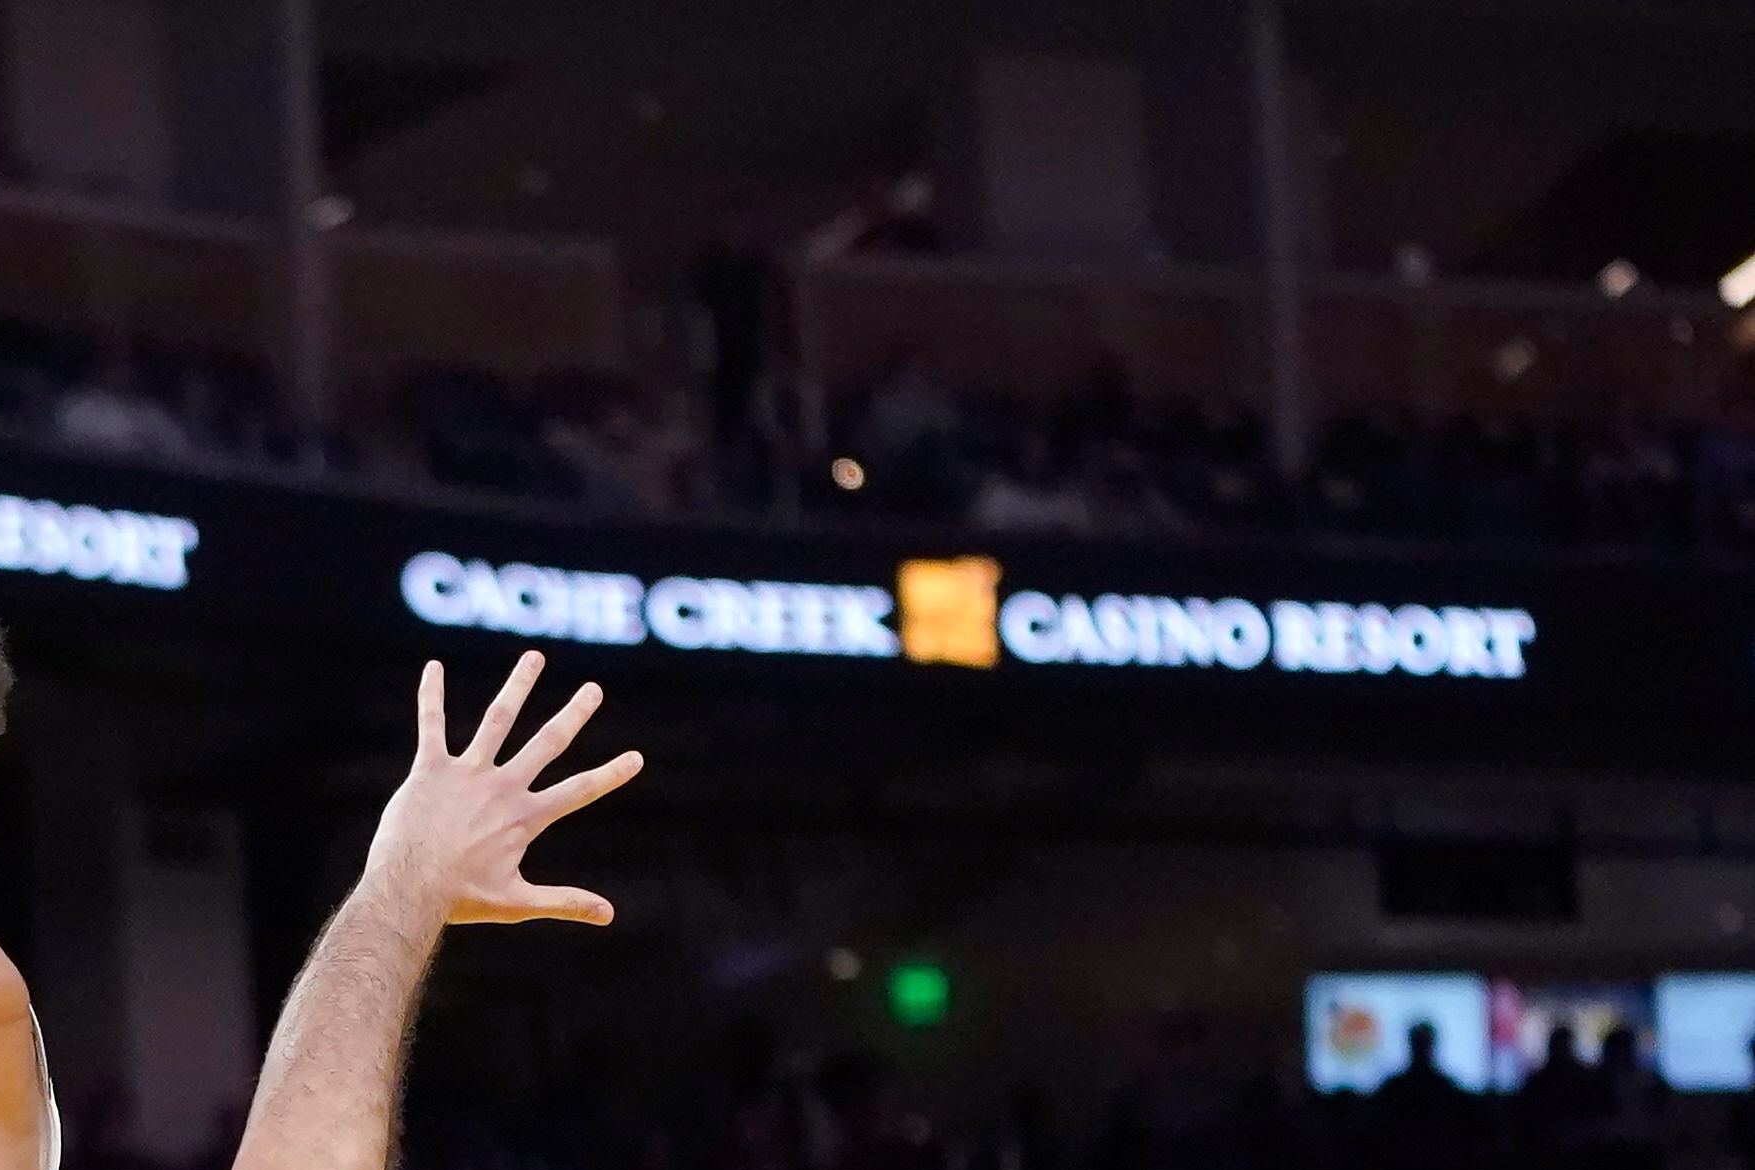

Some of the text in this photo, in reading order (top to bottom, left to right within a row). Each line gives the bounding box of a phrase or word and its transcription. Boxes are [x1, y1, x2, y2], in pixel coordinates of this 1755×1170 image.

[400, 551, 1537, 678] CACHE CREEK CASINO RESORT
